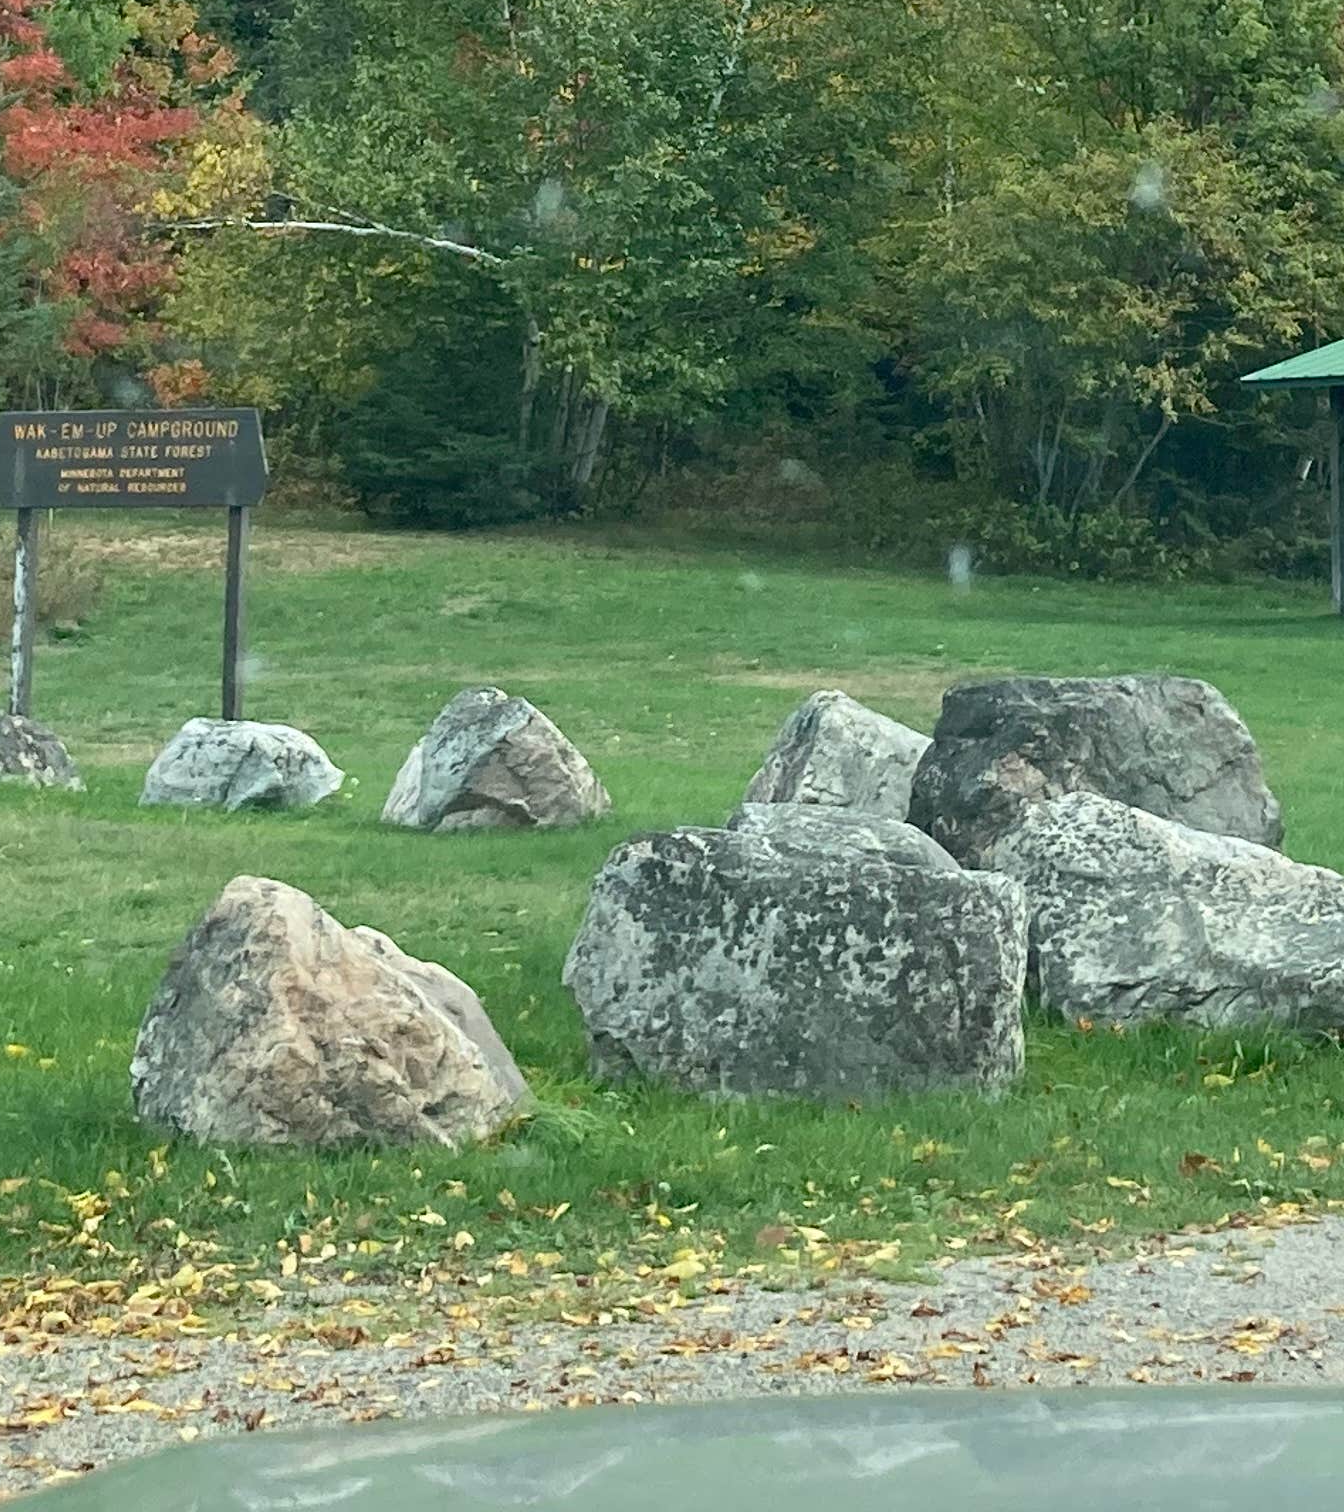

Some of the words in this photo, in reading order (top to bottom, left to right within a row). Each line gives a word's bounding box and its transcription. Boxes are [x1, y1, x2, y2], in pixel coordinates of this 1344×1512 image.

[126, 420, 239, 438] CAMPGROUND
[121, 445, 159, 459] STATE
[164, 444, 212, 458] FOREST
